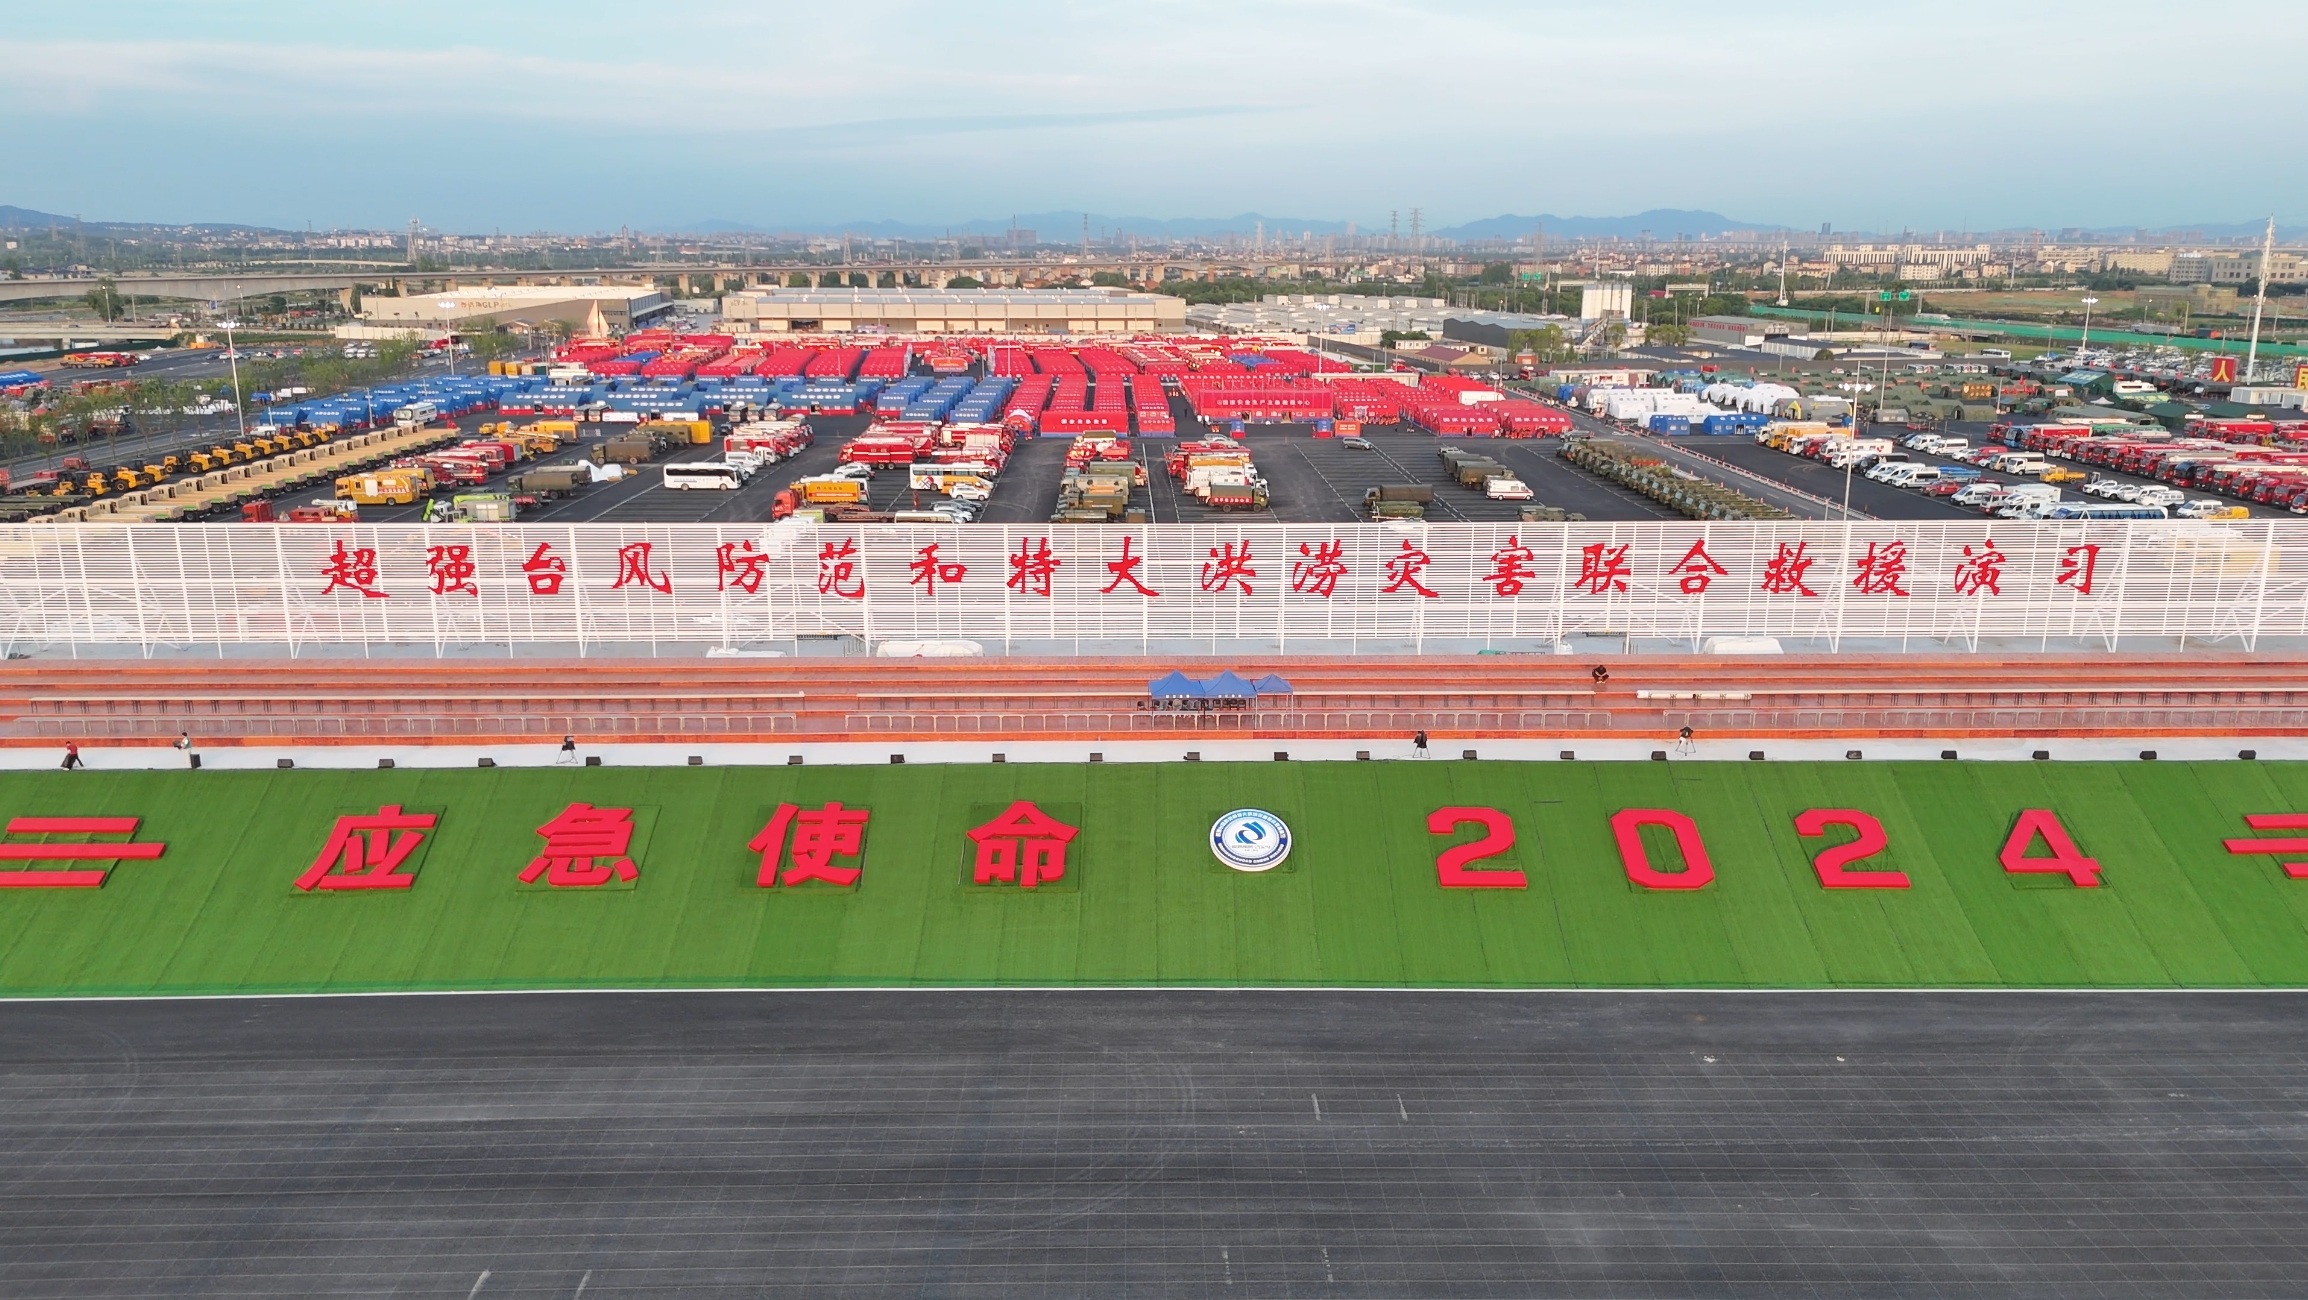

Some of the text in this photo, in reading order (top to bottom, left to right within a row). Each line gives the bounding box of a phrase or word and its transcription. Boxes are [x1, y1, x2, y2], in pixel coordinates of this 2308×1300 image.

[2212, 360, 2231, 383] 人
[323, 537, 2101, 600] 超强台风防范和特大洪涝灾害联合救援演习
[294, 801, 2103, 891] 应急使命 2024
